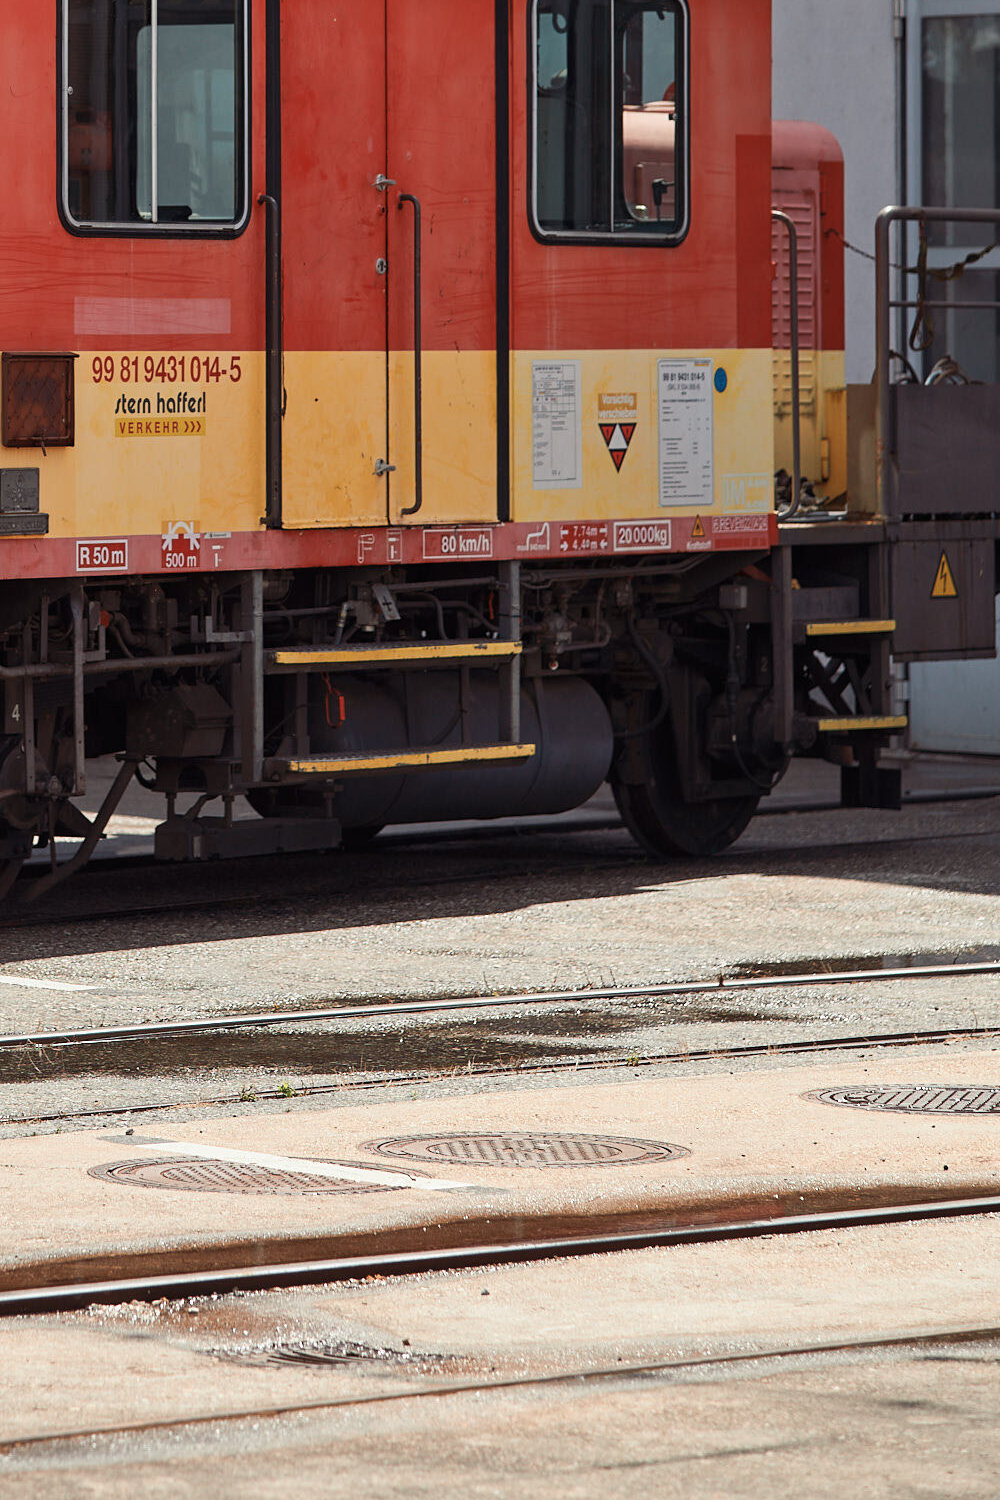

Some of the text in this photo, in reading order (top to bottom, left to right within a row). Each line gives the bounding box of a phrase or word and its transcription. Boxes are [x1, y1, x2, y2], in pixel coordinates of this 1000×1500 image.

[92, 356, 114, 383] 99
[120, 356, 138, 383] 81
[115, 391, 206, 414] stern hafferl
[119, 421, 179, 434] VERKEHR
[441, 534, 490, 553] 80 km/h
[80, 546, 124, 565] R 50 m
[165, 552, 197, 568] 500 m
[11, 703, 21, 722] 4
